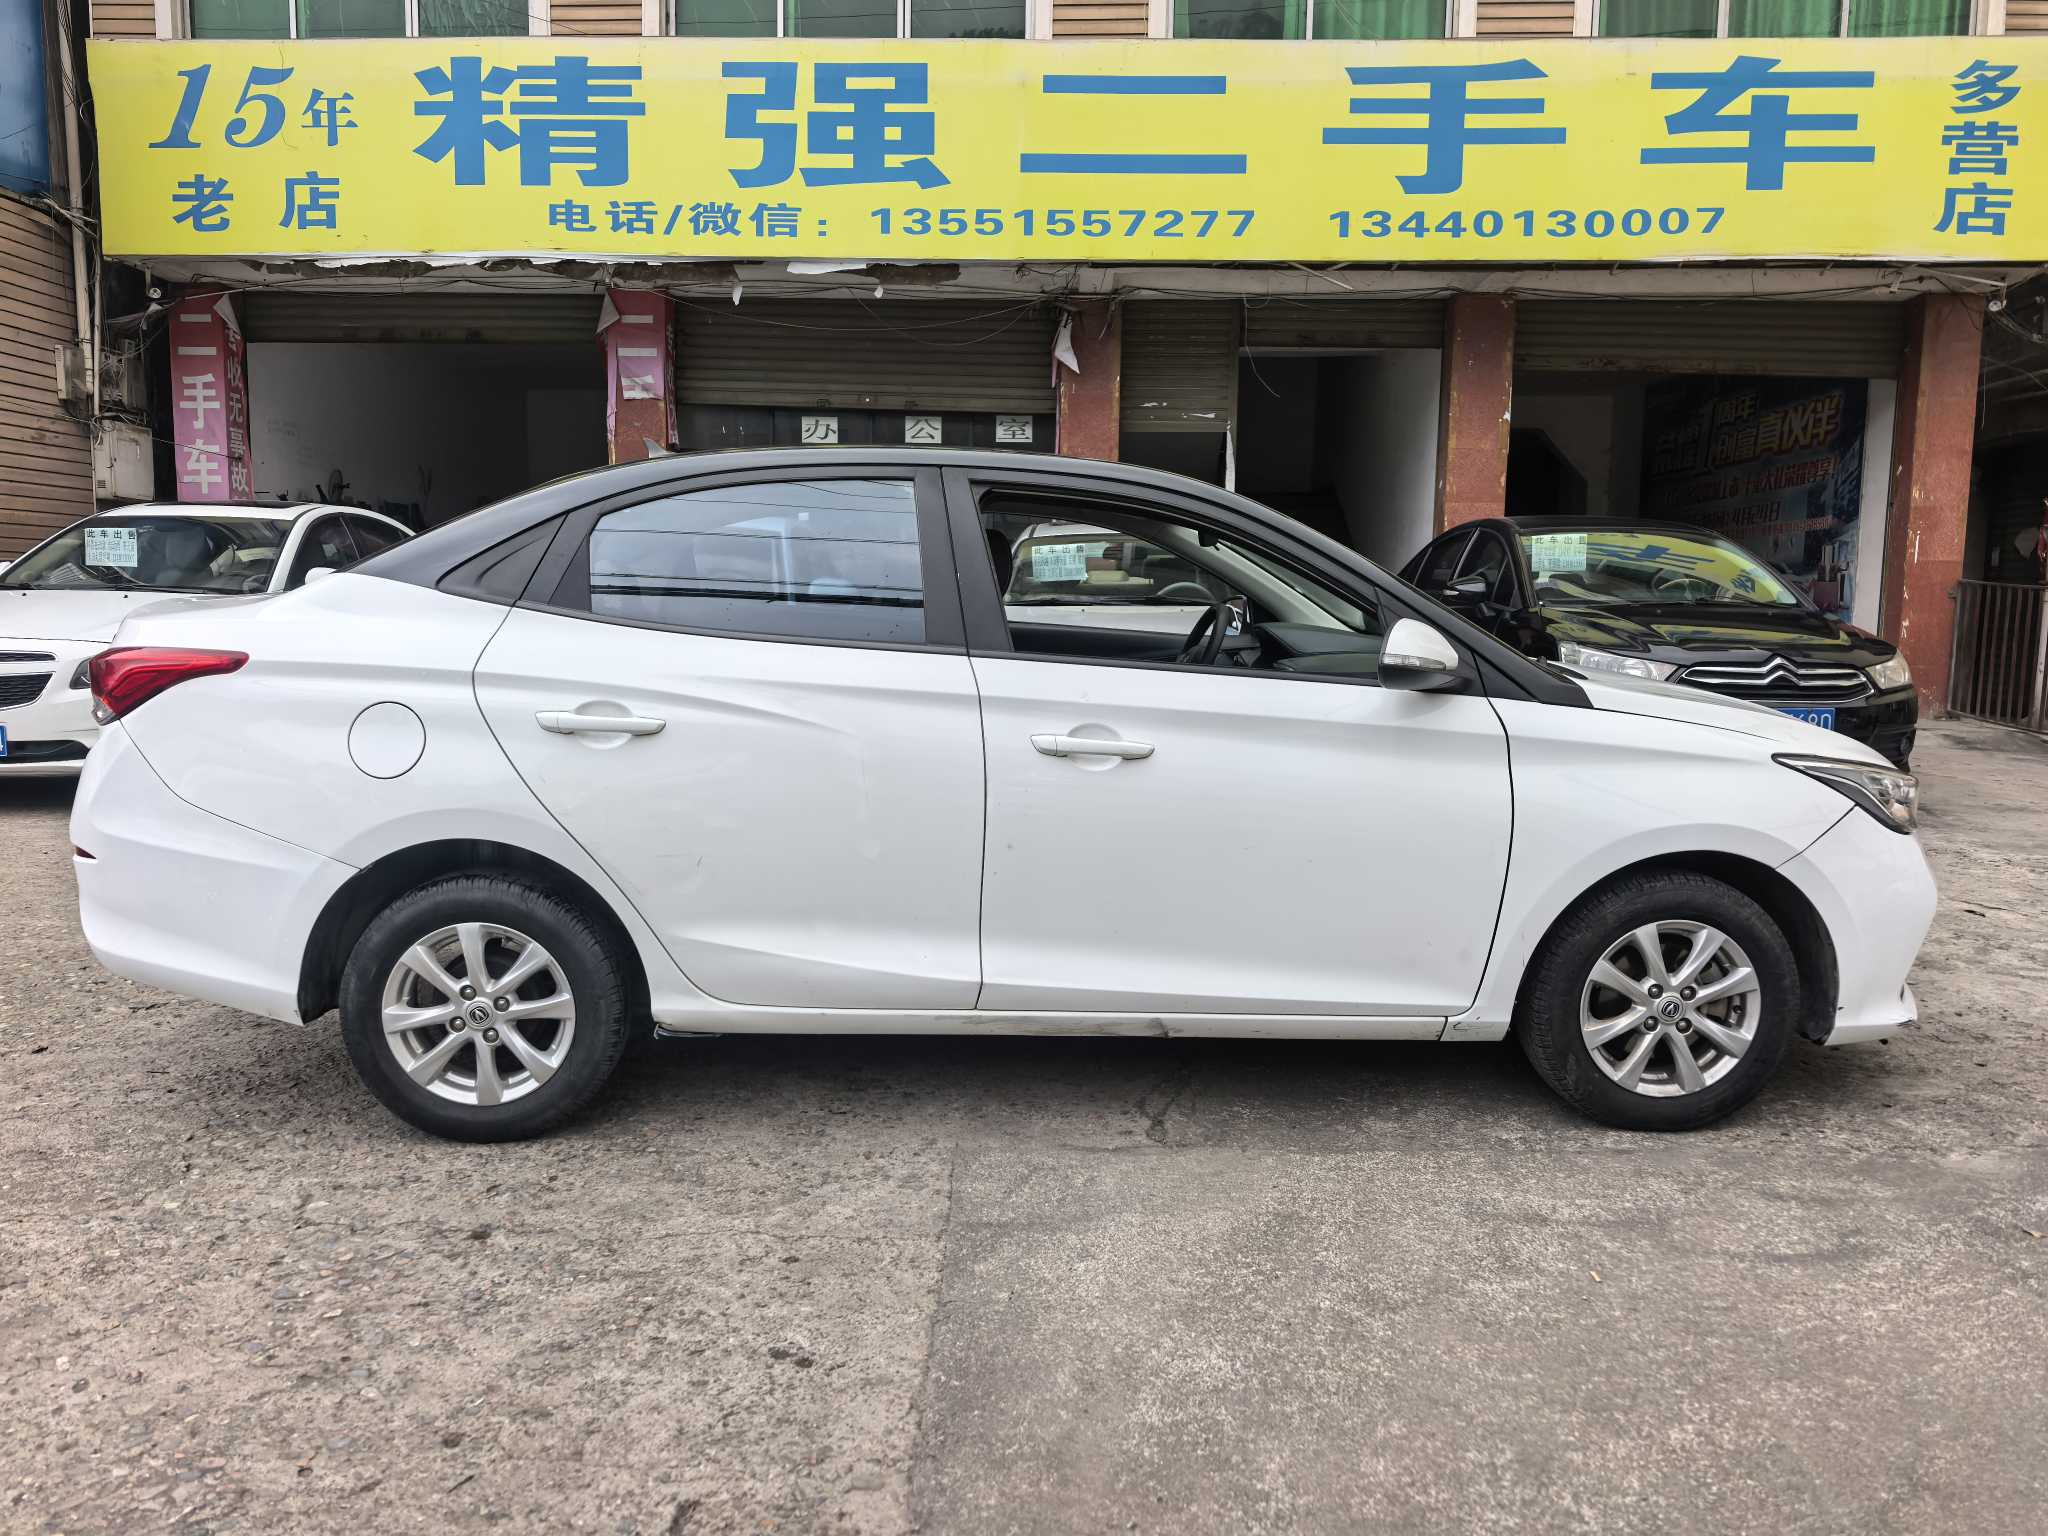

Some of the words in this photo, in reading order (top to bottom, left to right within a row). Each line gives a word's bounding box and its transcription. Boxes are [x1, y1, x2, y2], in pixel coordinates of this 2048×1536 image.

[148, 63, 358, 148] 15年
[415, 57, 1874, 194] 精强二手车
[1934, 60, 2021, 236] 多营店
[173, 171, 340, 232] 老店
[873, 208, 1253, 236] 13551557277
[1332, 208, 1724, 237] 13440130007
[177, 313, 222, 495] 二手车
[804, 418, 1031, 441] 办公室
